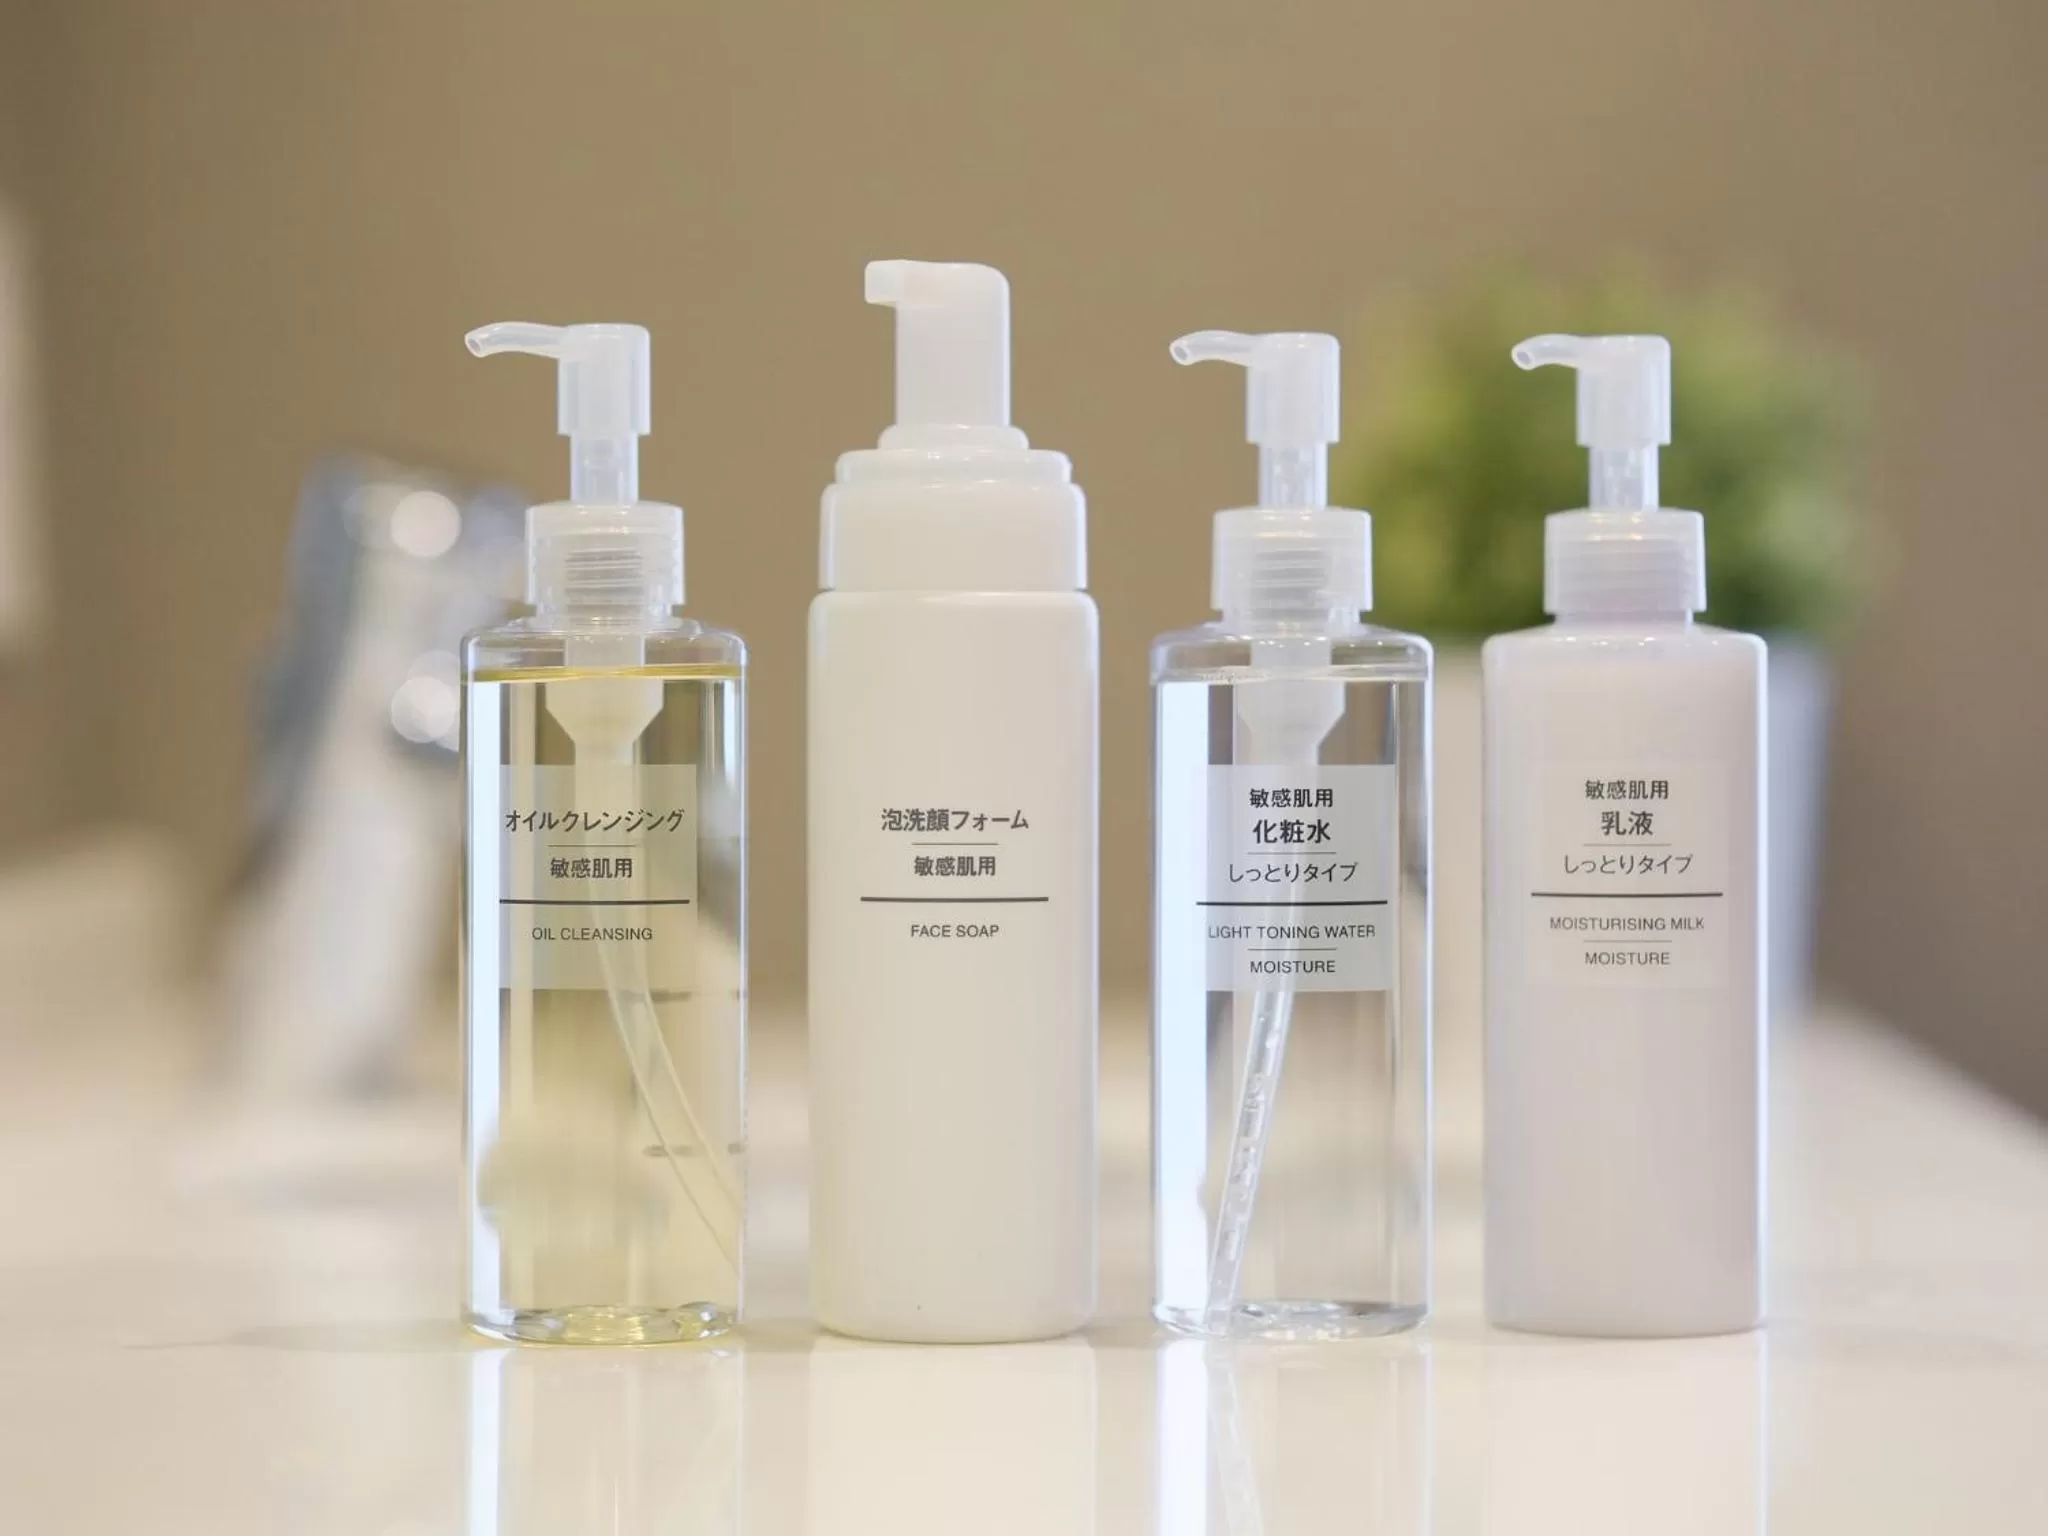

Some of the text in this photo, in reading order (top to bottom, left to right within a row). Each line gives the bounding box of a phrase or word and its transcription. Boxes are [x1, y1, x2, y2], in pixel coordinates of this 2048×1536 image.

[1249, 788, 1333, 808] 敏感肌用
[1585, 779, 1669, 800] 敏感肌用
[505, 809, 684, 832] オイルクレンジング
[881, 808, 1029, 832] 泡洗顔フォーム
[1601, 811, 1654, 836] 乳液
[1252, 819, 1331, 844] 化粧水
[550, 857, 633, 879] 敏感肌用
[914, 856, 996, 877] 敏感肌用
[1229, 861, 1358, 883] しっとりタイプ
[1564, 853, 1693, 875] しっとりタイプ
[531, 927, 653, 941] OIL CLEANSING
[910, 924, 999, 938] FACE SOAP
[1208, 924, 1376, 939] LIGHT TONING WATER
[1549, 917, 1704, 931] MOISTURISING MILK
[1250, 960, 1336, 974] MOISTURE
[1584, 952, 1671, 965] MOISTURE
